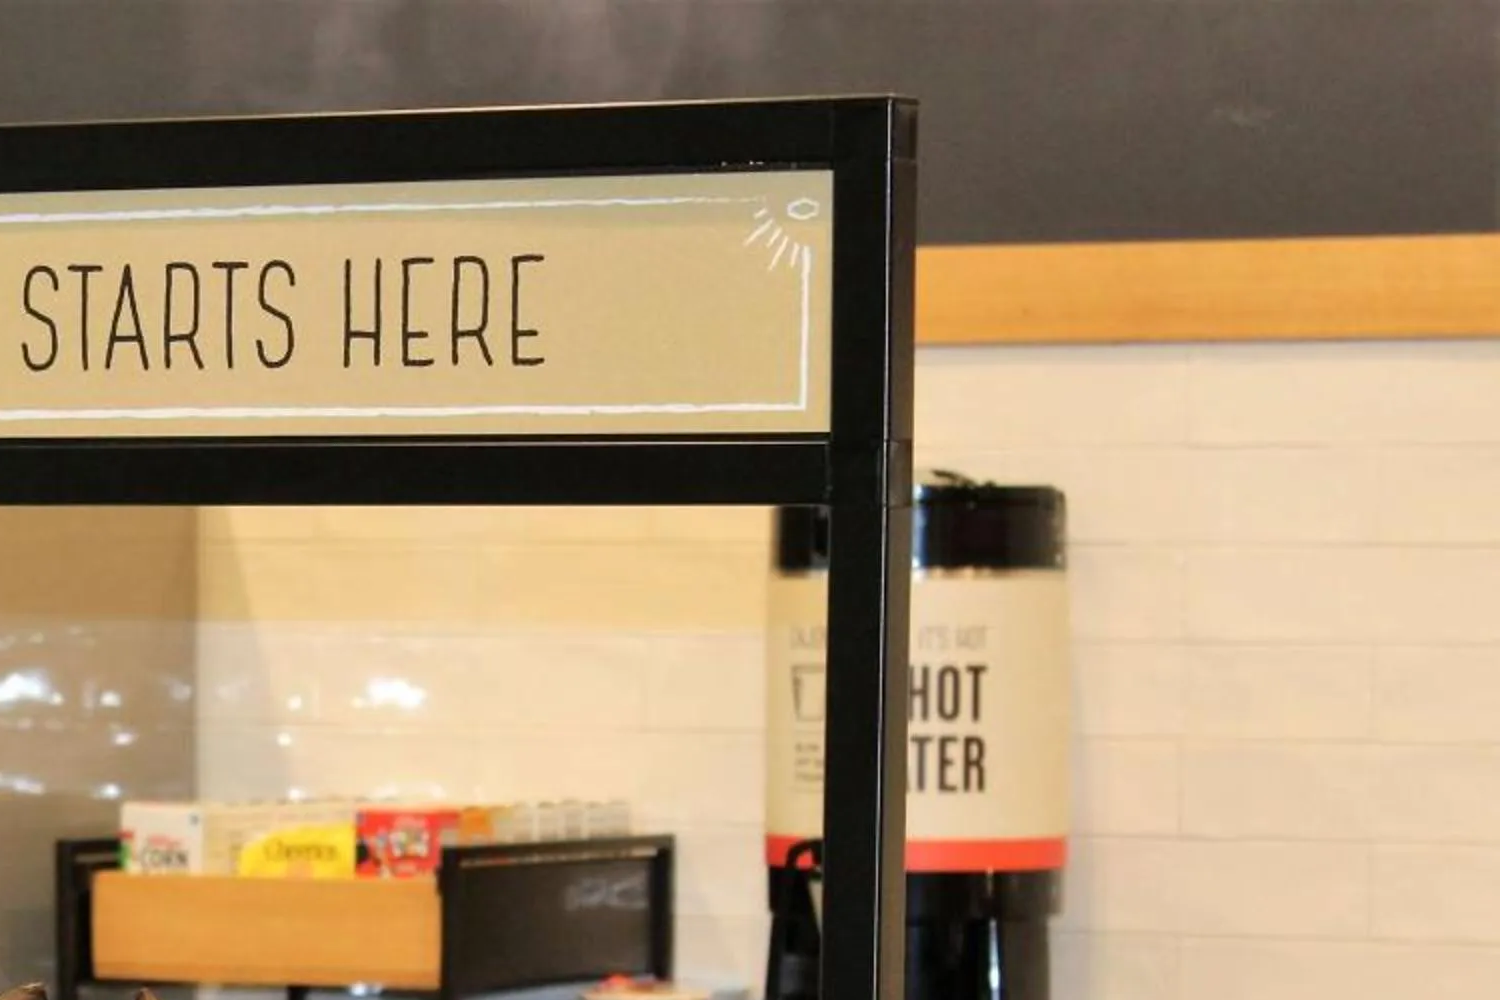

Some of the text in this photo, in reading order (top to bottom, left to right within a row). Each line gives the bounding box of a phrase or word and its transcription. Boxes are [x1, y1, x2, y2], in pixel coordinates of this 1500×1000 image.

[21, 259, 296, 372] STARTS
[343, 254, 545, 369] HERE
[908, 664, 988, 723] HOT
[908, 735, 986, 794] TER
